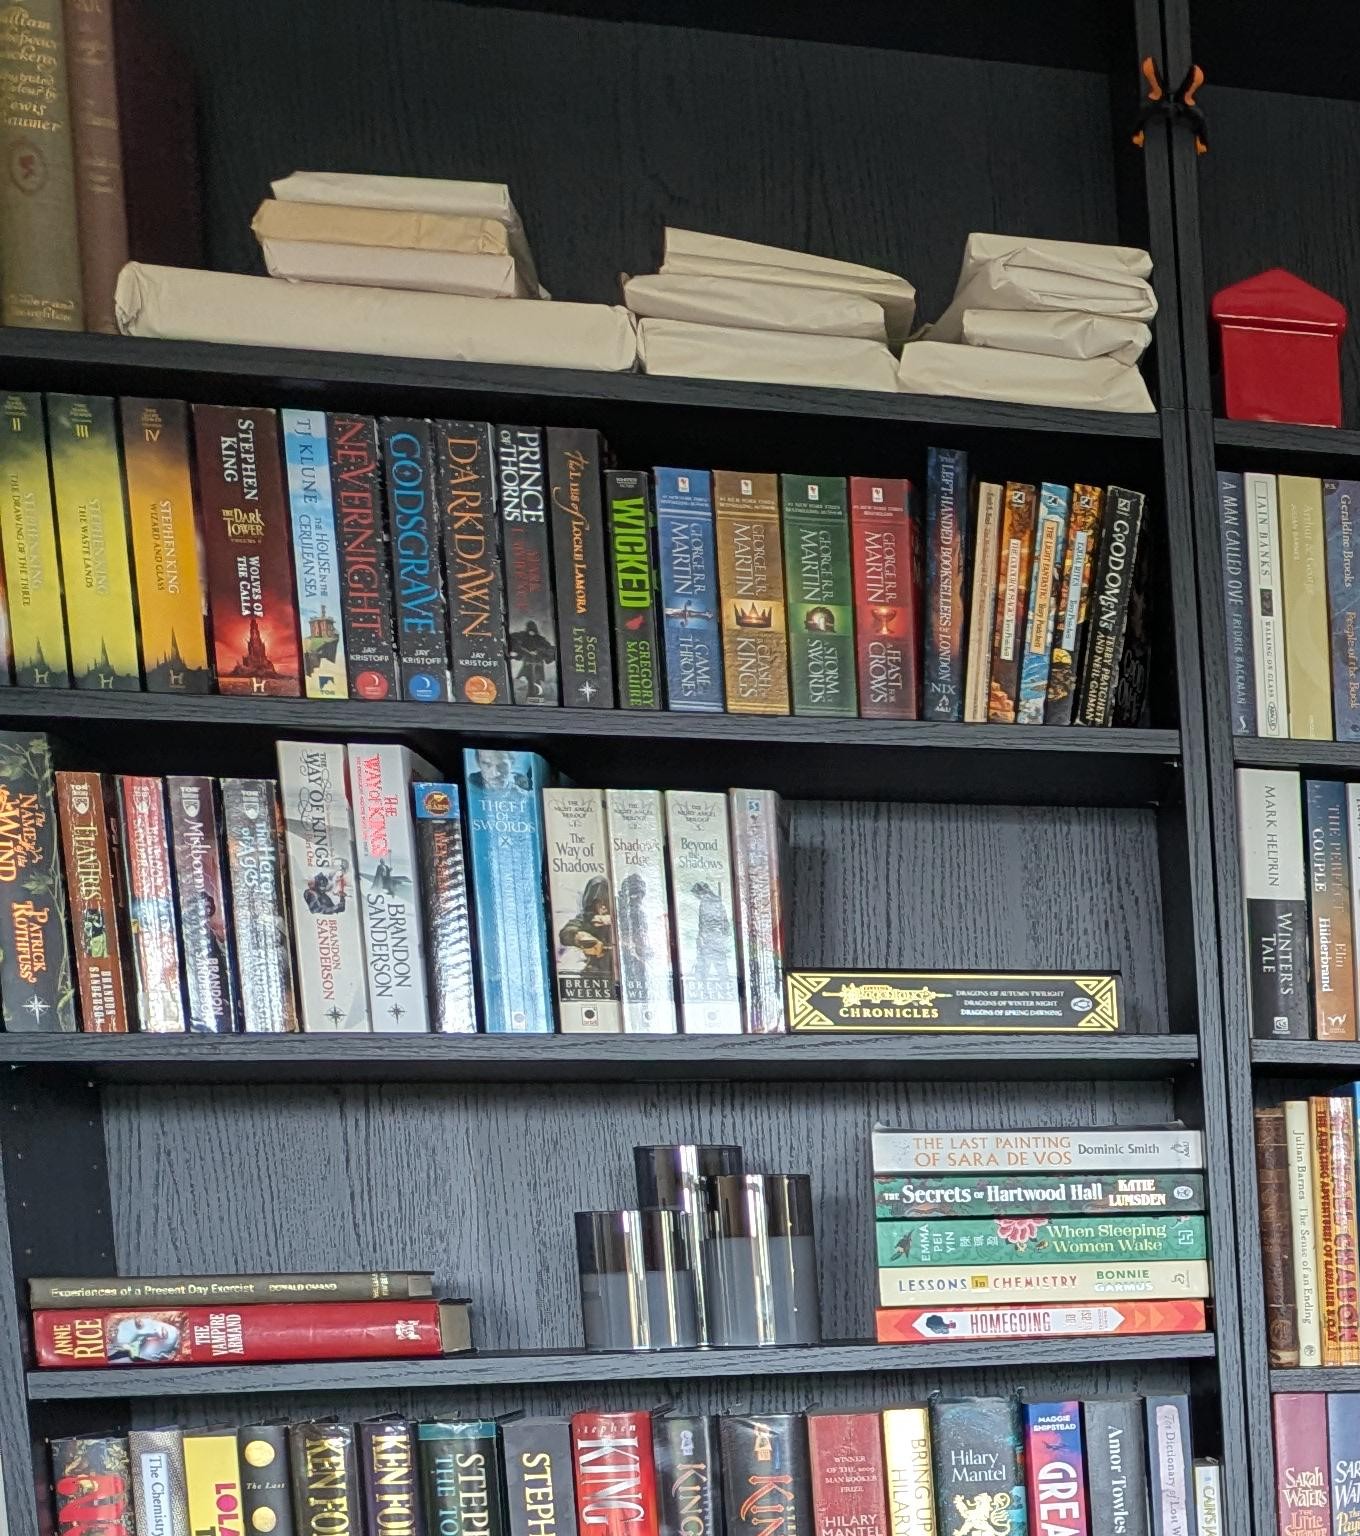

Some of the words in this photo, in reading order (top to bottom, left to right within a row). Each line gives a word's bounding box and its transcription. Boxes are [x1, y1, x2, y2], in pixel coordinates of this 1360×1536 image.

[220, 437, 237, 483] KING
[236, 419, 258, 501] STEPHEN
[334, 420, 384, 637] NEVERNIGHT
[389, 432, 440, 634] GODSGRAVE
[446, 437, 494, 638] DARKDAWN
[613, 496, 650, 608] WICKED
[365, 893, 392, 999] SANDERSON
[386, 902, 411, 989] BRANDON
[565, 978, 609, 989] BRENT
[565, 989, 611, 1000] WEEKS
[914, 1137, 944, 1149] THE
[950, 1137, 989, 1149] LAST
[996, 1136, 1071, 1149] PAINTING
[1078, 1144, 1124, 1155] Dominic
[1128, 1144, 1159, 1155] Smith
[915, 1153, 941, 1166] OF
[948, 1153, 999, 1166] SARA
[1007, 1152, 1028, 1165] DE
[1032, 1151, 1072, 1165] VOS
[883, 1192, 900, 1200] THE
[902, 1185, 972, 1203] Secrets
[987, 1184, 1066, 1201] Hartwood
[1070, 1183, 1102, 1200] Hall
[1046, 1225, 1094, 1238] When
[1098, 1224, 1167, 1240] Sleeping
[1053, 1239, 1114, 1252] Women
[1119, 1239, 1162, 1252] Wake
[898, 1278, 967, 1292] LESSONS
[993, 1276, 1078, 1289] CHEMISTRY
[970, 1313, 1051, 1334] HOMEGOING
